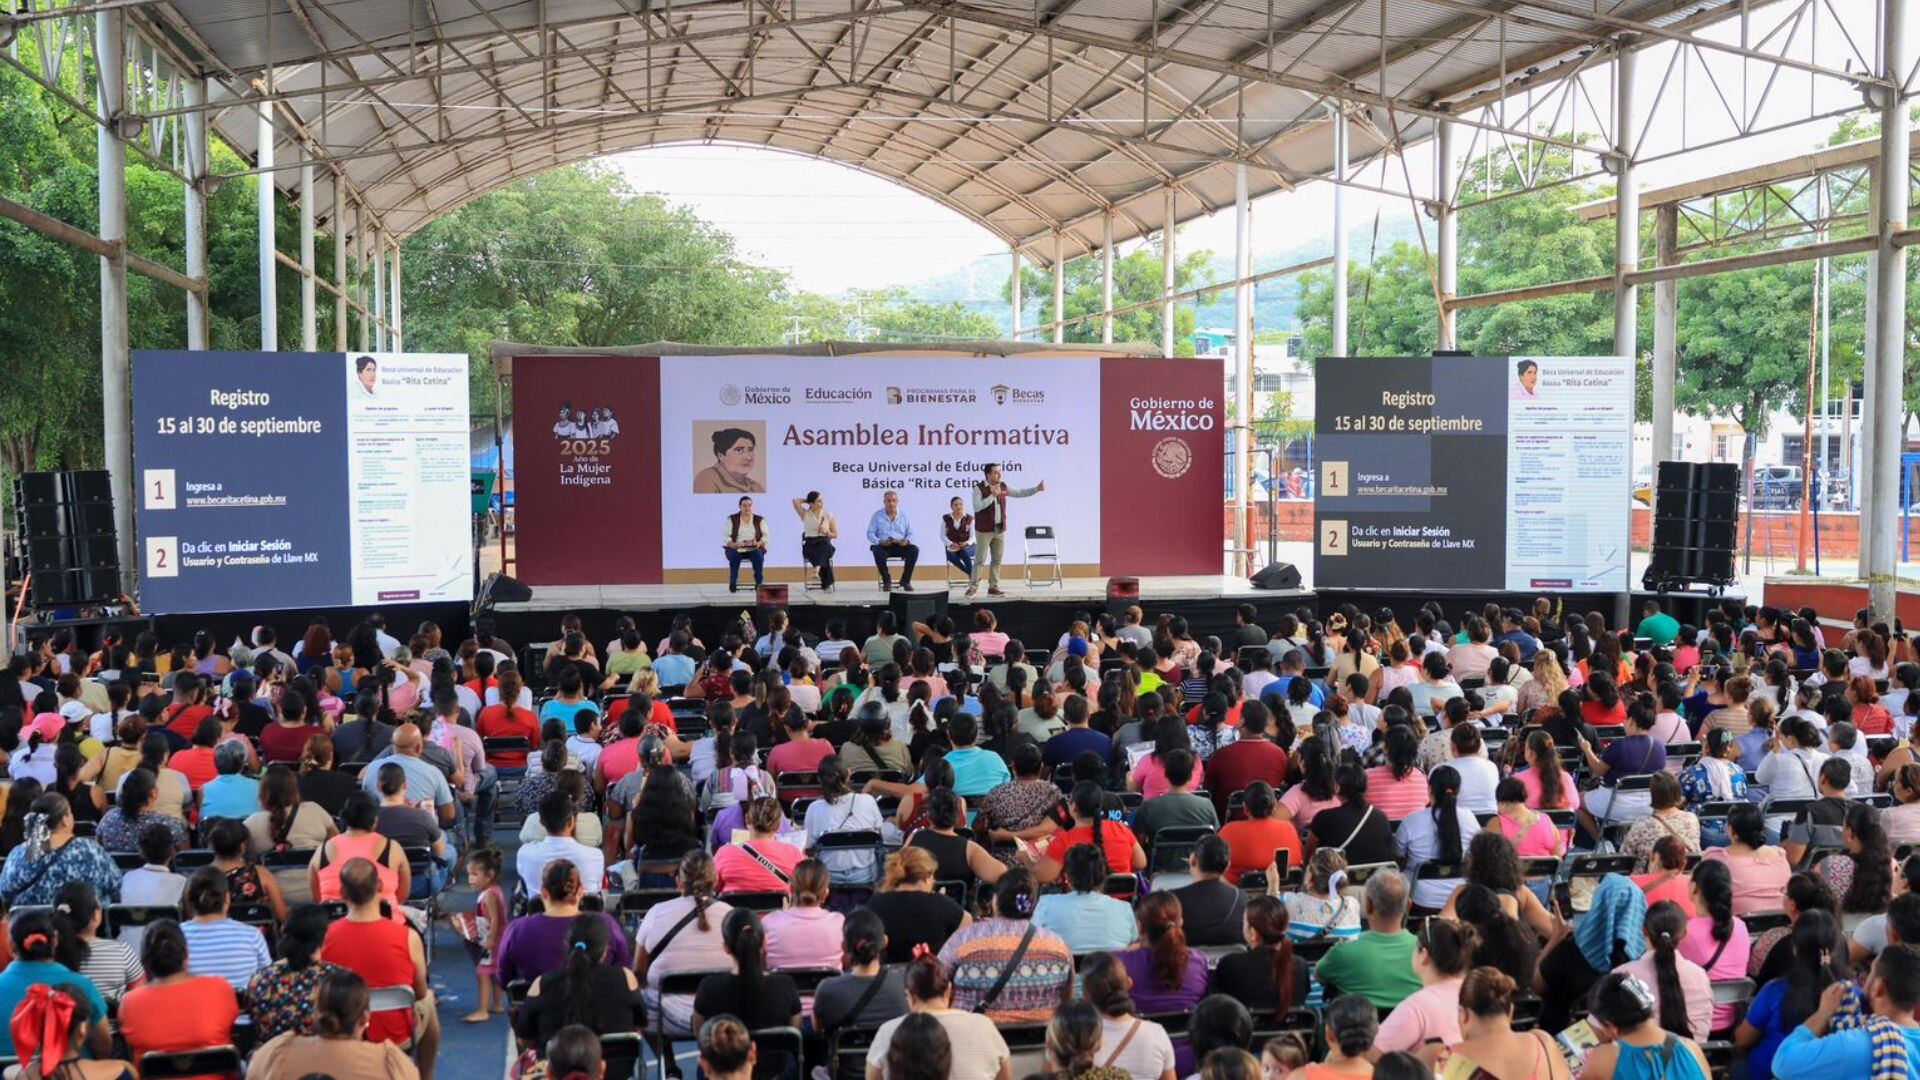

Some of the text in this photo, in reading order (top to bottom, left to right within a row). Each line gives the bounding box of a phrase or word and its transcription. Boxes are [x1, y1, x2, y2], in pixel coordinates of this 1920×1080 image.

[210, 388, 270, 409] Registro
[744, 392, 791, 405] México
[805, 387, 872, 399] Educación
[906, 394, 976, 403] BIENESTAR
[1012, 388, 1045, 399] Becas
[1130, 396, 1214, 409] Gobierno de
[1382, 391, 1436, 409] Registro
[157, 415, 322, 437] 15 al 30 de septiembre
[1130, 410, 1214, 431] México
[1335, 415, 1483, 434] 15 al 30 de septiembre
[782, 423, 1069, 446] Asamblea Informativa
[560, 440, 610, 455] 2025
[560, 464, 612, 475] La Mujer
[832, 460, 1022, 473] Beca Universal de Edución
[561, 475, 611, 487] Indígena
[862, 476, 905, 489] Básica
[945, 476, 980, 489] Cetin
[1329, 471, 1339, 488] 1
[1357, 472, 1383, 483] Ingresa
[153, 481, 165, 500] 1
[186, 481, 216, 493] Ingresa
[1357, 484, 1448, 496] www.becaritacetina.gob.mx
[186, 494, 287, 507] www.becaritacetina.gob.mx
[1352, 526, 1451, 537] Da clic en Iniciar Sesión
[1328, 530, 1338, 547] 2
[1352, 538, 1475, 550] Usuario y Contraseña de Llave MX
[182, 538, 292, 553] Da clic en Iniciar Sesión
[155, 548, 167, 568] 2
[182, 552, 318, 568] Usuario y Contraseña de Llave MX
